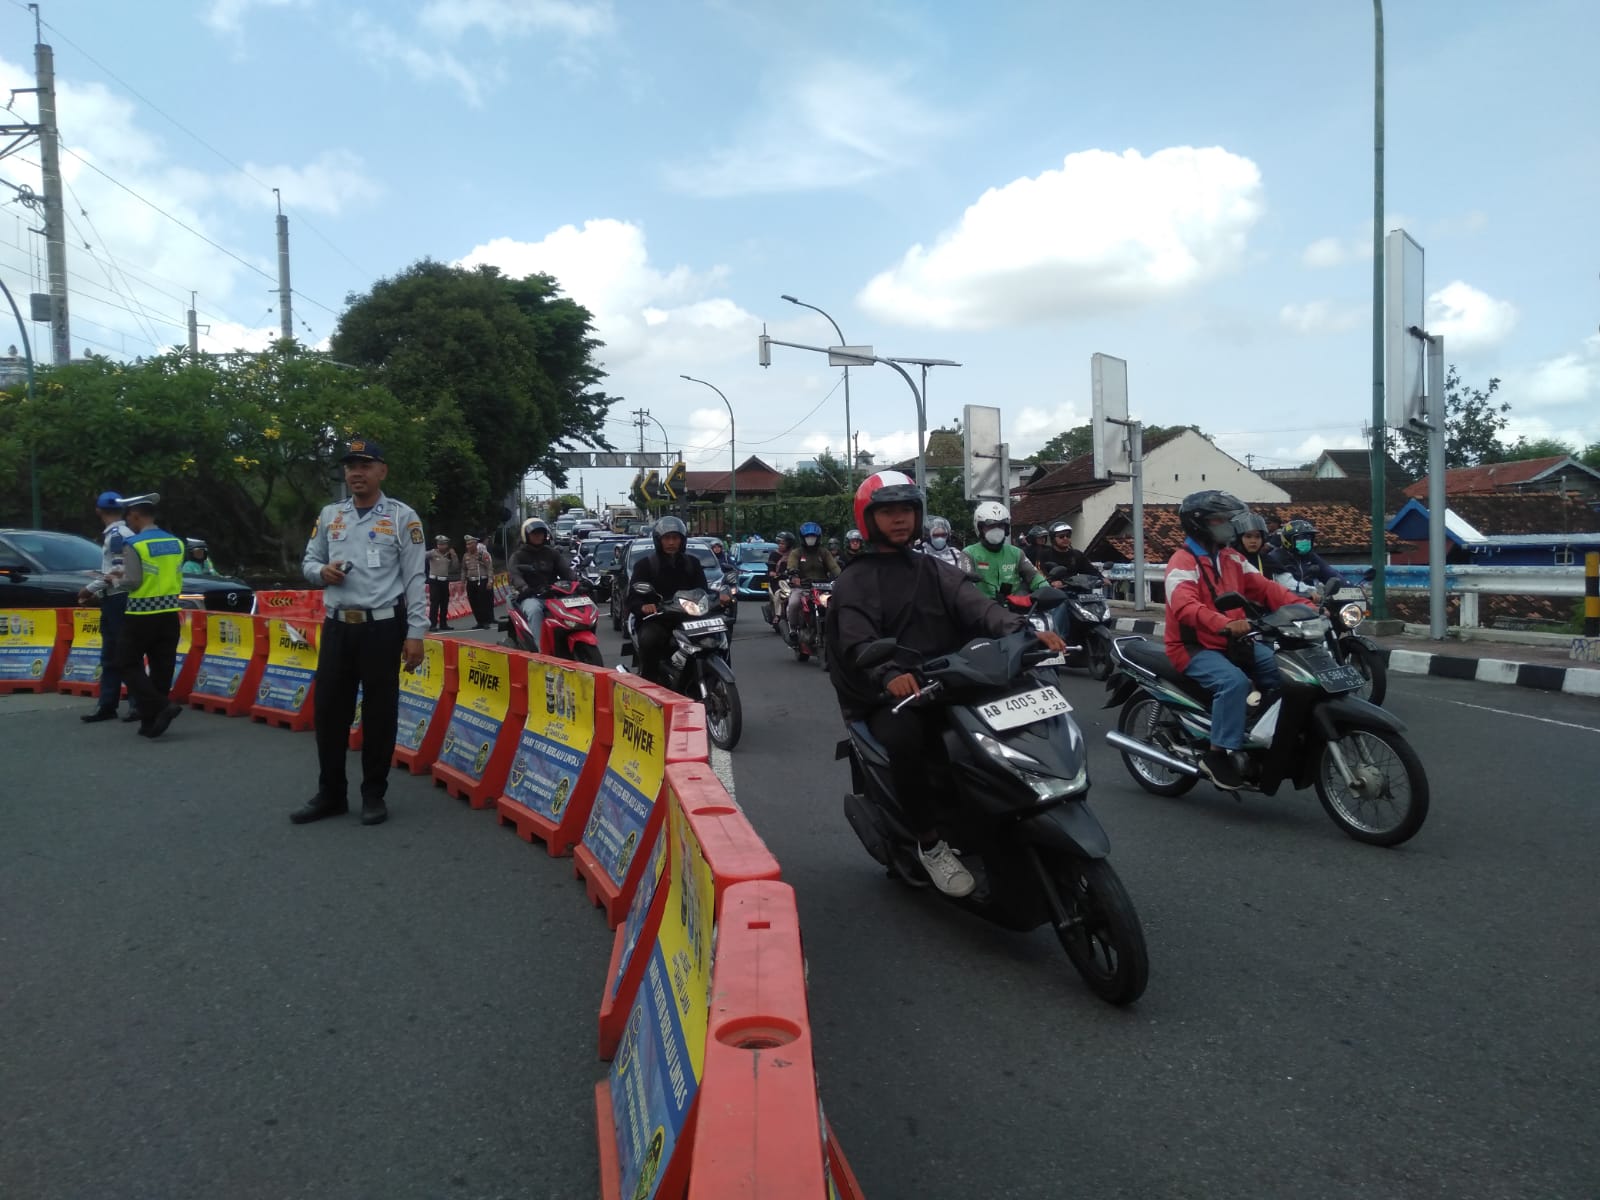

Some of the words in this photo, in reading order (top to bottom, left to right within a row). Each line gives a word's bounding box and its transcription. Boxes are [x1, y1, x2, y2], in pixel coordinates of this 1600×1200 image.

[468, 669, 500, 692] POWER
[983, 704, 1001, 719] AB
[1006, 694, 1037, 712] 4005
[1041, 689, 1058, 701] JR
[622, 719, 656, 757] POWER
[653, 977, 668, 1022] TERTIB
[660, 1009, 678, 1067] BERLALU
[668, 1053, 688, 1112] LINTAS
